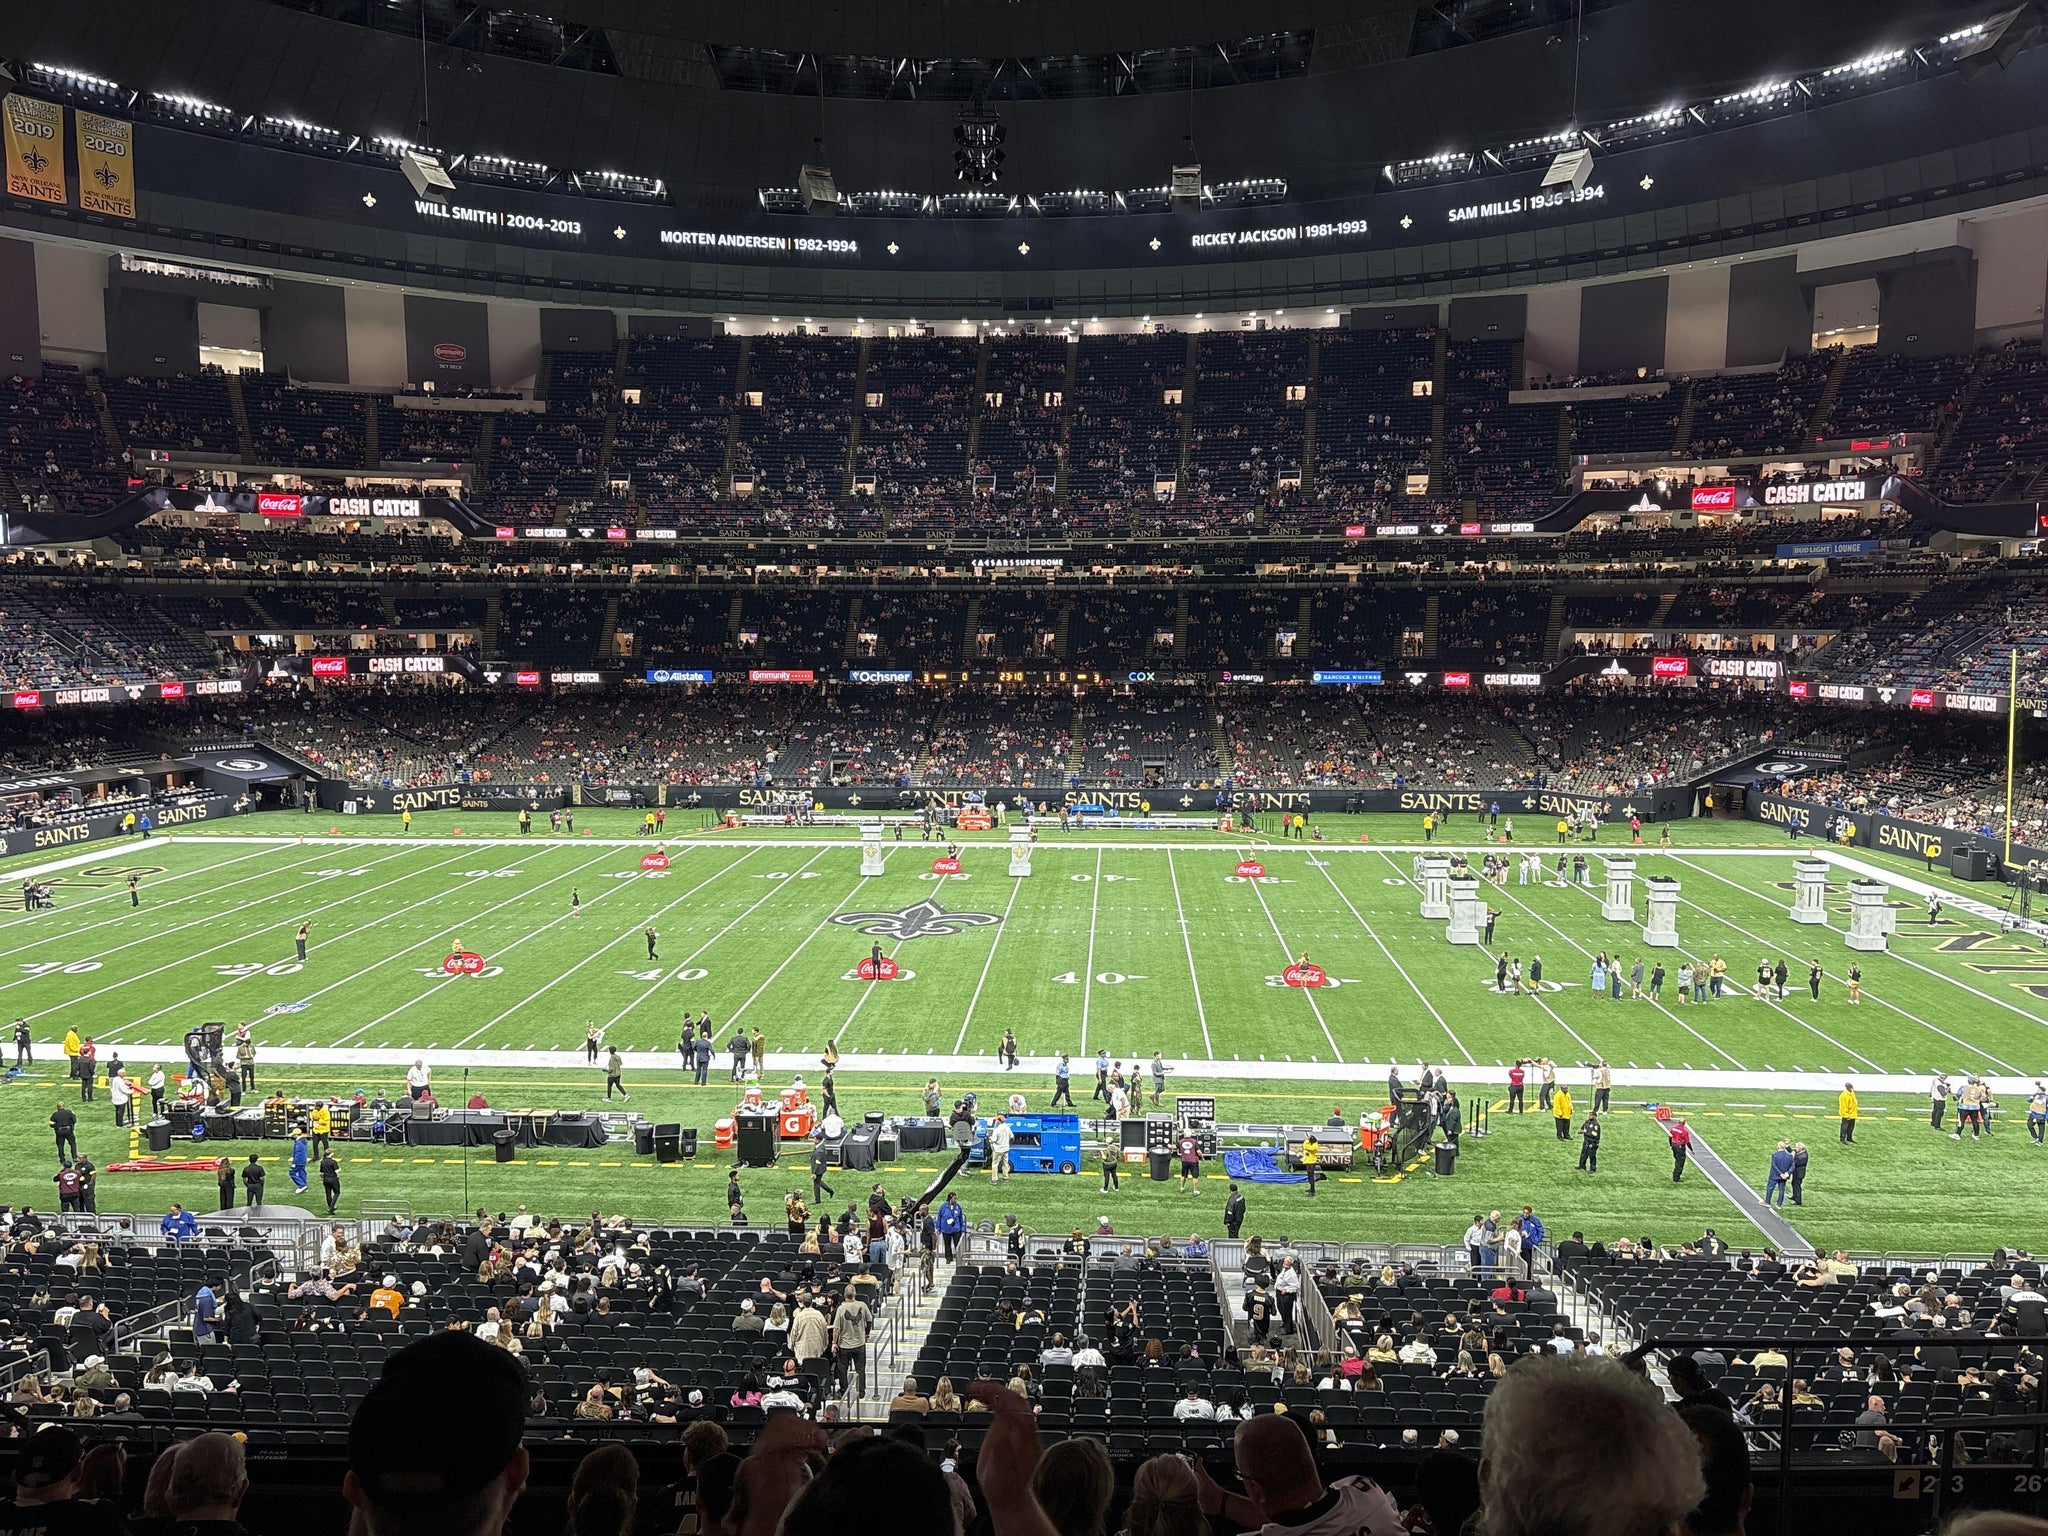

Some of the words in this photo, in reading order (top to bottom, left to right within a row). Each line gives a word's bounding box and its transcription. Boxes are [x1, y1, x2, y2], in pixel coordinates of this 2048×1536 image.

[13, 119, 55, 139] 2019
[81, 122, 128, 139] CHAMPIONS
[85, 136, 126, 156] 2020
[11, 181, 62, 200] SAINTS
[84, 197, 132, 215] SAINTS
[1448, 206, 1477, 222] SAM
[1481, 199, 1521, 217] MILLS
[415, 201, 450, 217] WILL
[452, 206, 497, 224] SMITH
[507, 214, 581, 234] 2004-2013
[1192, 232, 1237, 247] RICKEY
[1238, 227, 1296, 244] JACKSON
[1305, 220, 1367, 237] 1981-1993
[661, 231, 715, 245] MORTEN
[717, 234, 785, 249] ANDERSEN
[793, 238, 857, 252] 1982-1994
[1694, 491, 1732, 505] Coca-Cola
[1765, 484, 1810, 505] CASH
[1812, 481, 1866, 503] CATCH
[261, 498, 296, 511] Coca-Cola
[330, 498, 370, 516] CASH
[372, 499, 420, 516] CATCH
[525, 528, 544, 537] CASH
[544, 528, 567, 538] CATCH
[719, 529, 750, 538] SAINTS
[1199, 529, 1230, 537] SAINTS
[1269, 528, 1301, 536] SAINTS
[1377, 526, 1395, 535] CASH
[1396, 525, 1418, 535] CATCH
[1492, 524, 1510, 533] CASH
[1511, 523, 1534, 532] CATCH
[636, 529, 654, 538] CASH
[655, 530, 677, 539] CATCH
[789, 530, 820, 538] SAINTS
[857, 531, 888, 539] SAINTS
[925, 531, 956, 539] SAINTS
[1130, 530, 1161, 538] SAINTS
[174, 549, 207, 557] SAINTS
[1703, 548, 1737, 556] SAINTS
[1834, 543, 1861, 553] LOUNGE
[246, 551, 279, 560] SAINTS
[318, 553, 351, 561] SAINTS
[1558, 552, 1590, 560] SAINTS
[1630, 550, 1663, 558] SAINTS
[530, 556, 560, 564] SAINTS
[663, 557, 693, 565] SAINTS
[727, 558, 756, 566] SAINTS
[792, 558, 820, 566] SAINTS
[971, 559, 1014, 567] CAESARS
[1215, 557, 1244, 565] SAINTS
[1280, 556, 1310, 564] SAINTS
[313, 661, 344, 672] Coca-Cola
[369, 658, 402, 672] CASH
[405, 658, 443, 671] CATCH
[1655, 661, 1685, 672] Coca-Cola
[1711, 660, 1744, 676] CASH
[551, 673, 572, 683] CASH
[573, 673, 599, 683] CATCH
[752, 672, 790, 681] Community
[859, 672, 910, 681] Ochsner
[1129, 671, 1155, 681] COX
[1233, 673, 1263, 682] entergy
[1484, 674, 1509, 684] CASH
[1510, 674, 1540, 685] CATCH
[196, 682, 217, 694] CASH
[218, 681, 241, 692] CATCH
[1819, 685, 1838, 697] CASH
[1839, 687, 1863, 700] CATCH
[56, 691, 79, 704] CASH
[81, 689, 109, 702] CATCH
[1946, 695, 1967, 709] CASH
[1969, 696, 1996, 711] CATCH
[2015, 698, 2047, 709] SAINTS
[393, 788, 460, 811] SAINTS
[462, 800, 488, 808] SAINTS
[1065, 791, 1141, 808] SAINTS
[1401, 792, 1480, 810] SAINTS
[158, 804, 207, 825] SAINTS
[1760, 801, 1810, 828] SAINTS
[35, 823, 90, 847] SAINTS
[1879, 824, 1941, 857] SAINTS
[643, 858, 666, 867] Coca-Cola
[934, 862, 958, 871] Coca-Cola
[1237, 865, 1262, 875] Coca-Cola
[216, 962, 303, 975] 20
[631, 969, 709, 981] 40
[1051, 971, 1126, 984] 40
[785, 1117, 800, 1133] G
[1254, 1303, 1265, 1321] 9
